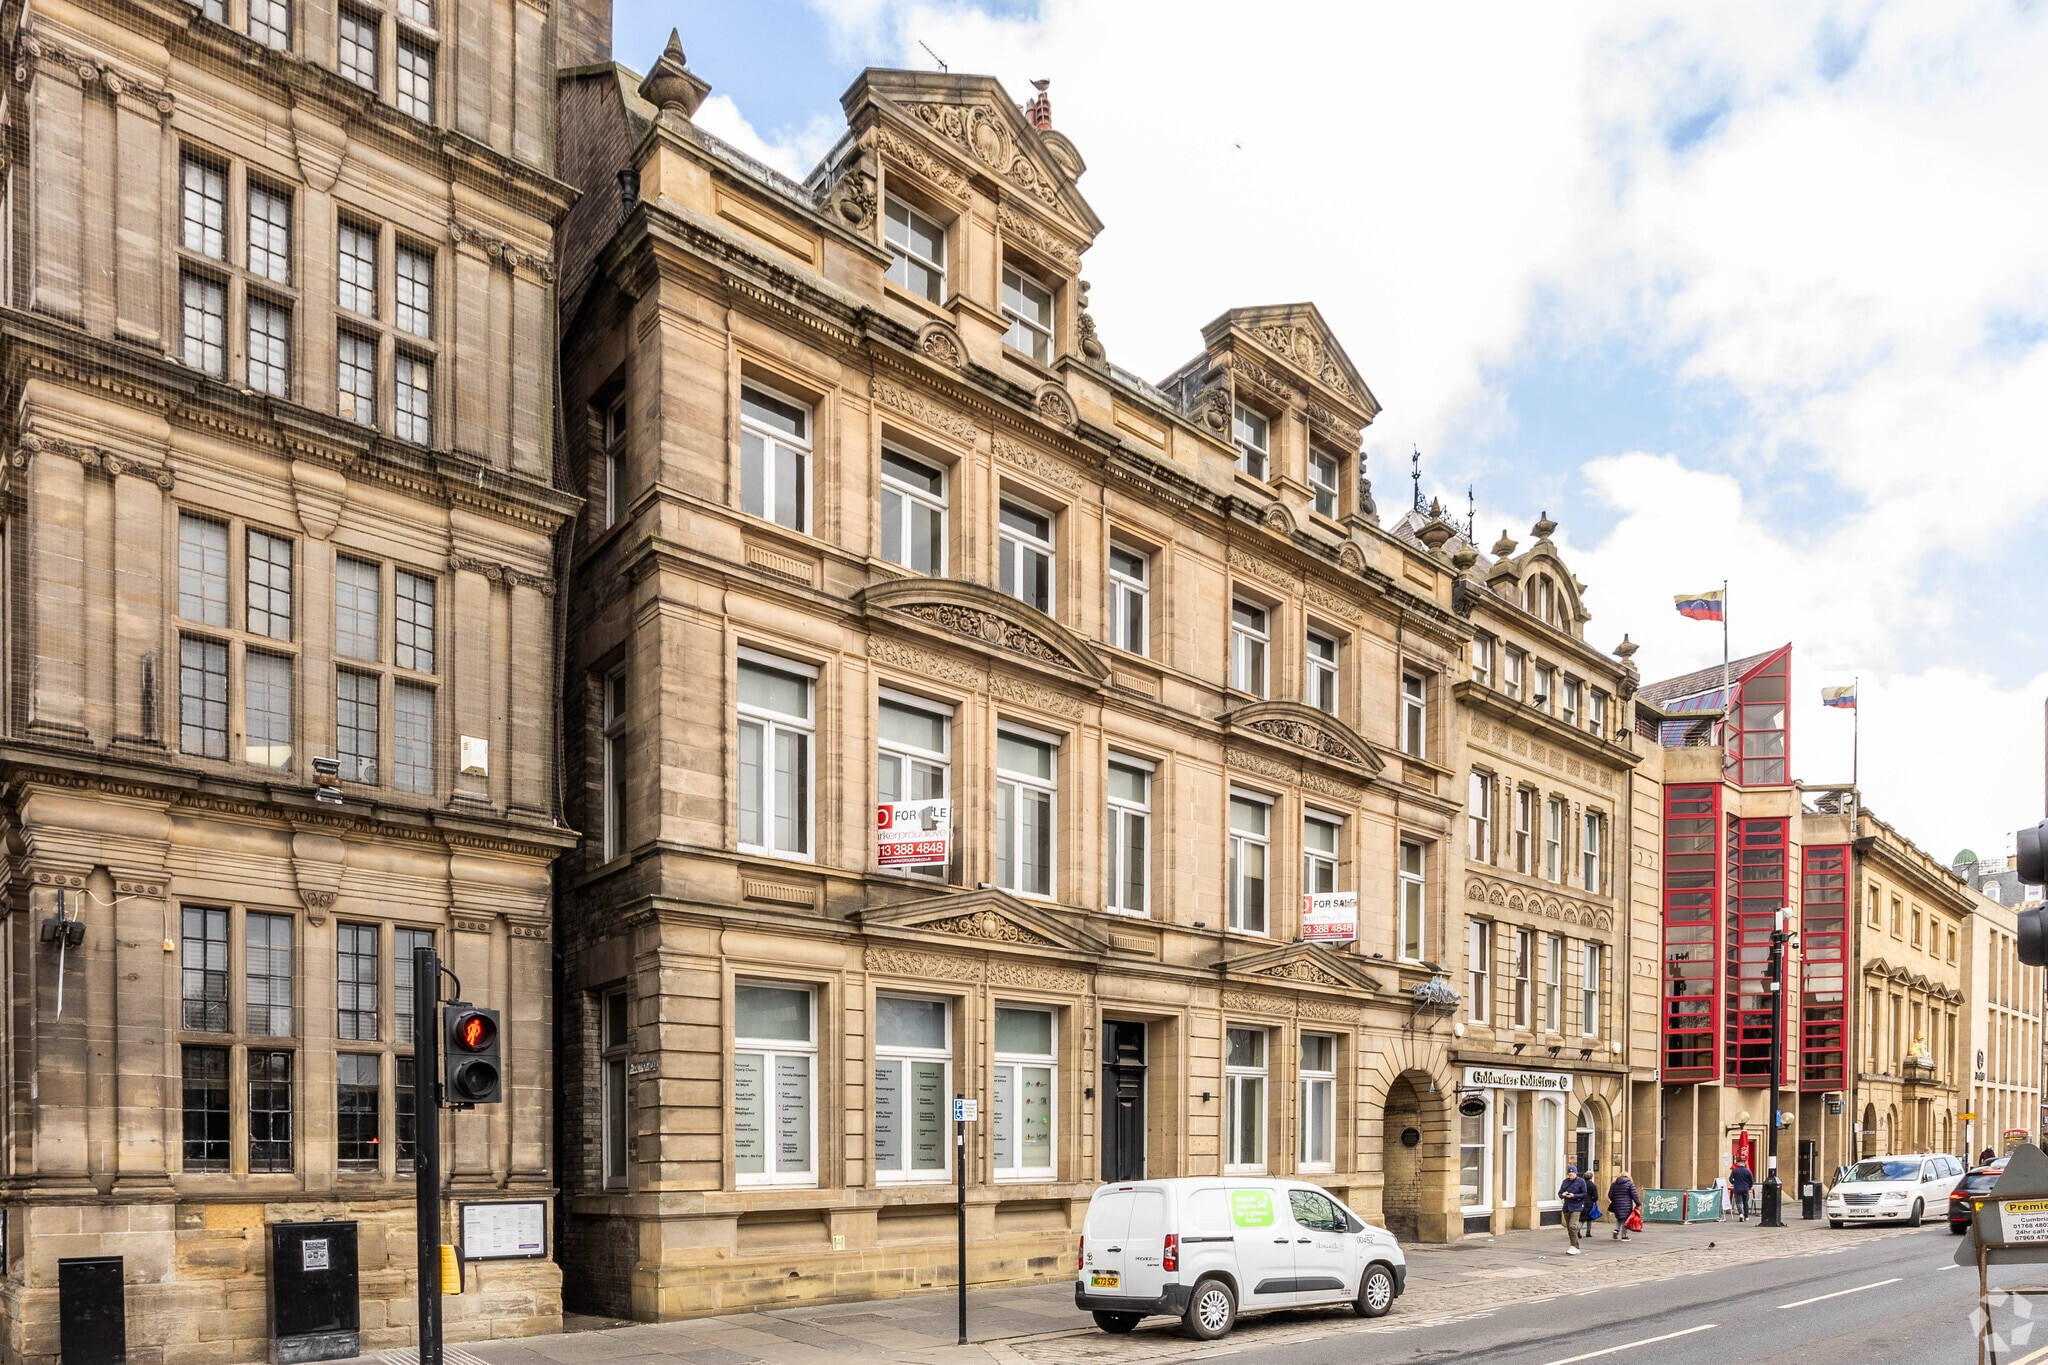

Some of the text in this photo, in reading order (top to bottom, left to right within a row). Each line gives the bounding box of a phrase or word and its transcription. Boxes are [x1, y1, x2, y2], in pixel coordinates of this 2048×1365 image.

[895, 811, 916, 820] FOR
[894, 844, 914, 855] 388
[916, 842, 943, 854] 4848
[1314, 900, 1330, 908] FOR
[1332, 924, 1352, 932] 4848
[1473, 1071, 1557, 1088] Goldwaters Solicitors
